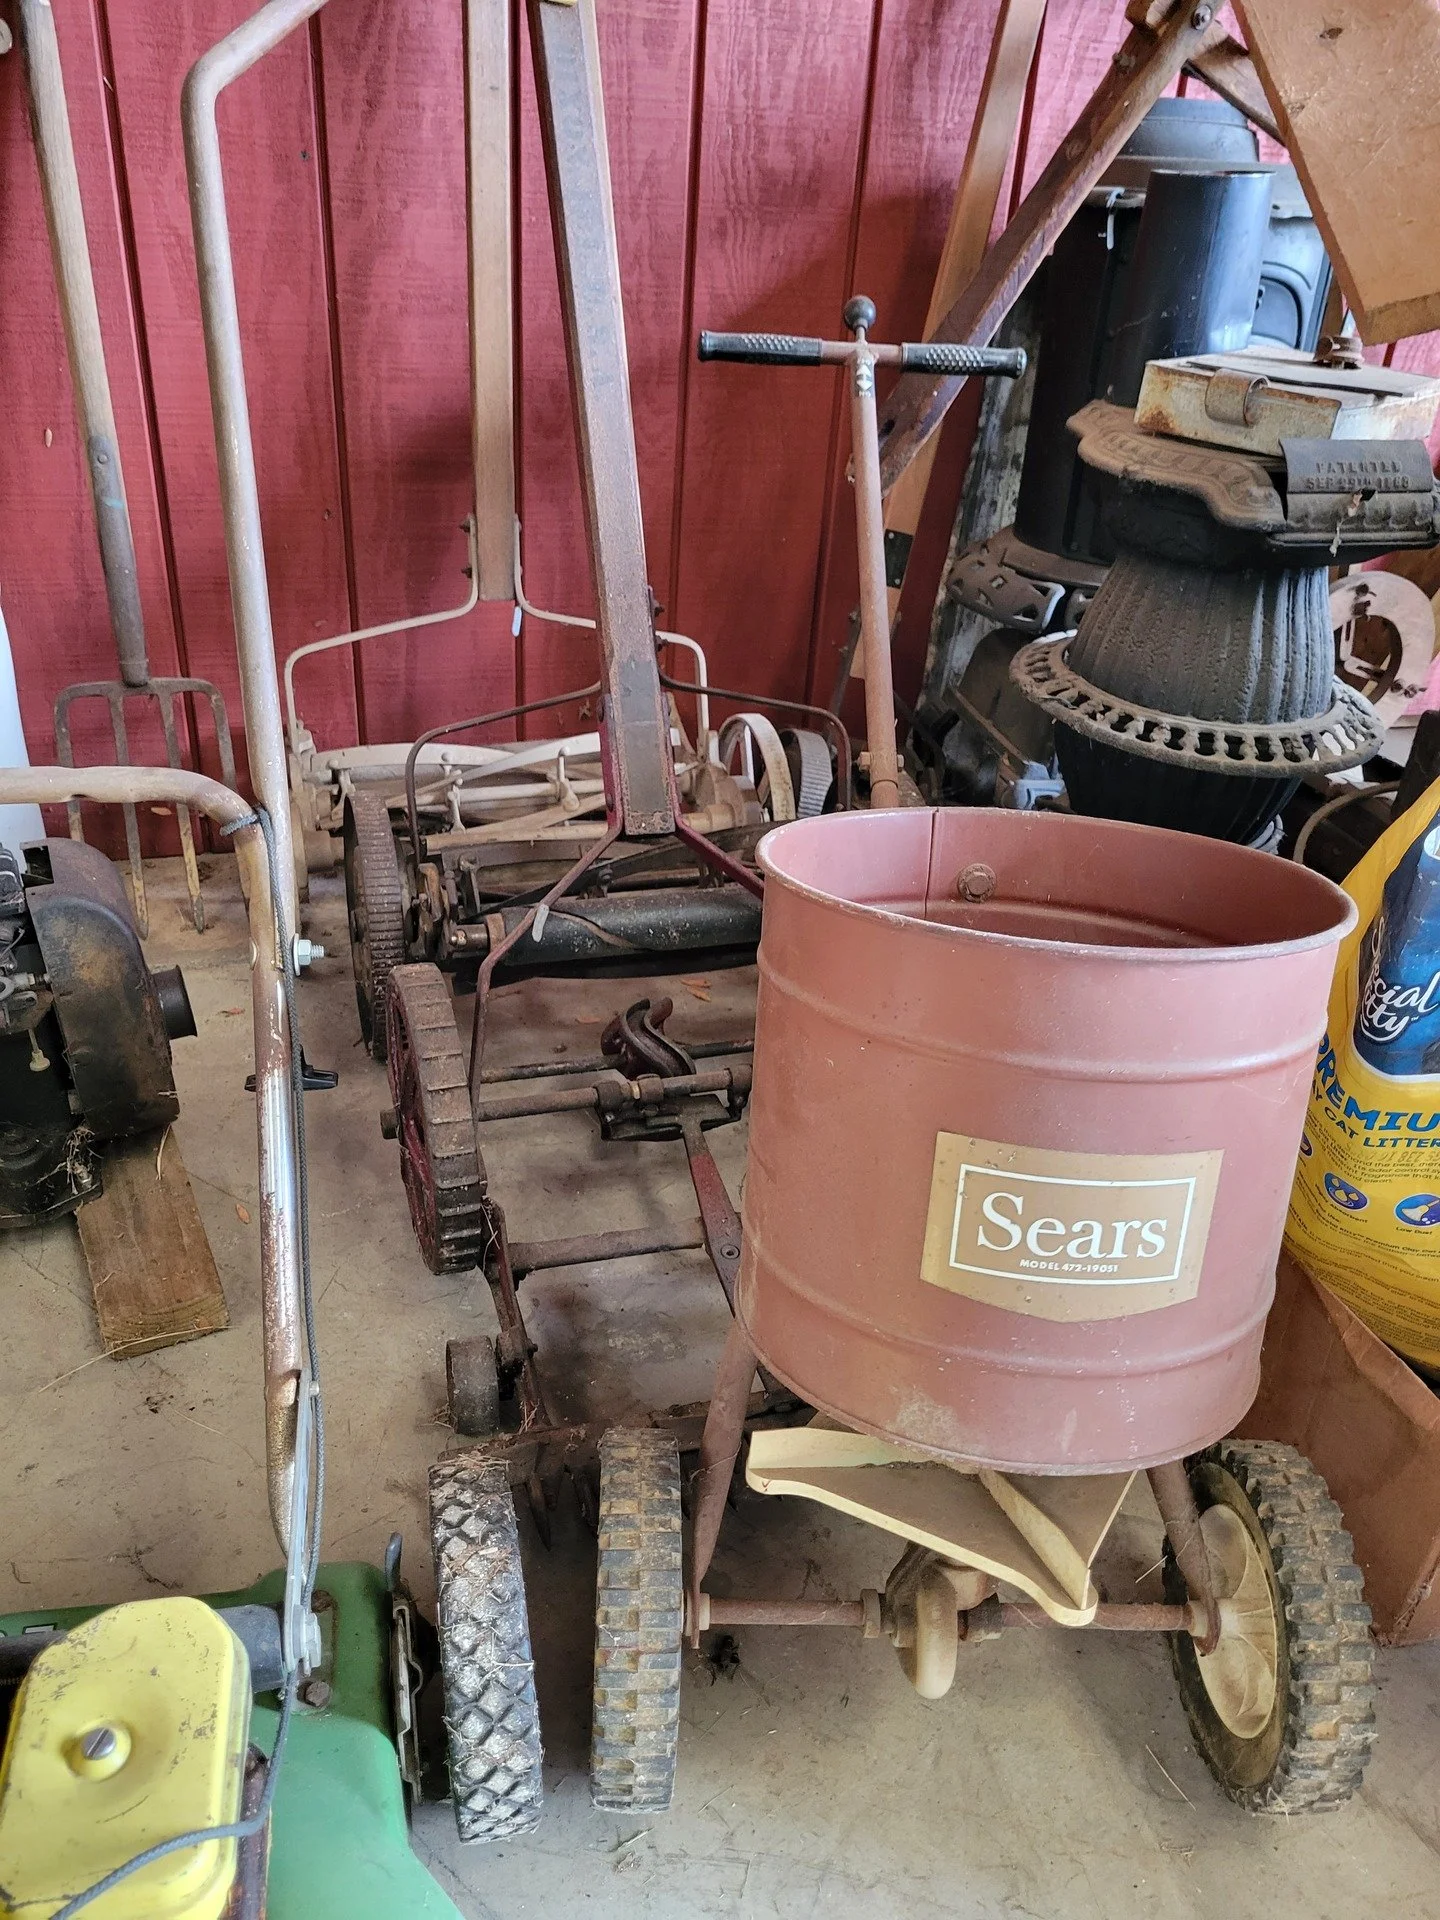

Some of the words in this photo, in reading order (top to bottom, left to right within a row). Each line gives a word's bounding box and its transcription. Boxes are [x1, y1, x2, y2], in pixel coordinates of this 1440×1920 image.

[1317, 1033, 1440, 1132] PREMIU
[1324, 1106, 1359, 1139] CAT
[1363, 1136, 1440, 1148] LITTER
[976, 1191, 1168, 1259] Sears
[1020, 1259, 1060, 1271] MODEL
[1061, 1263, 1119, 1273] 472-19051
